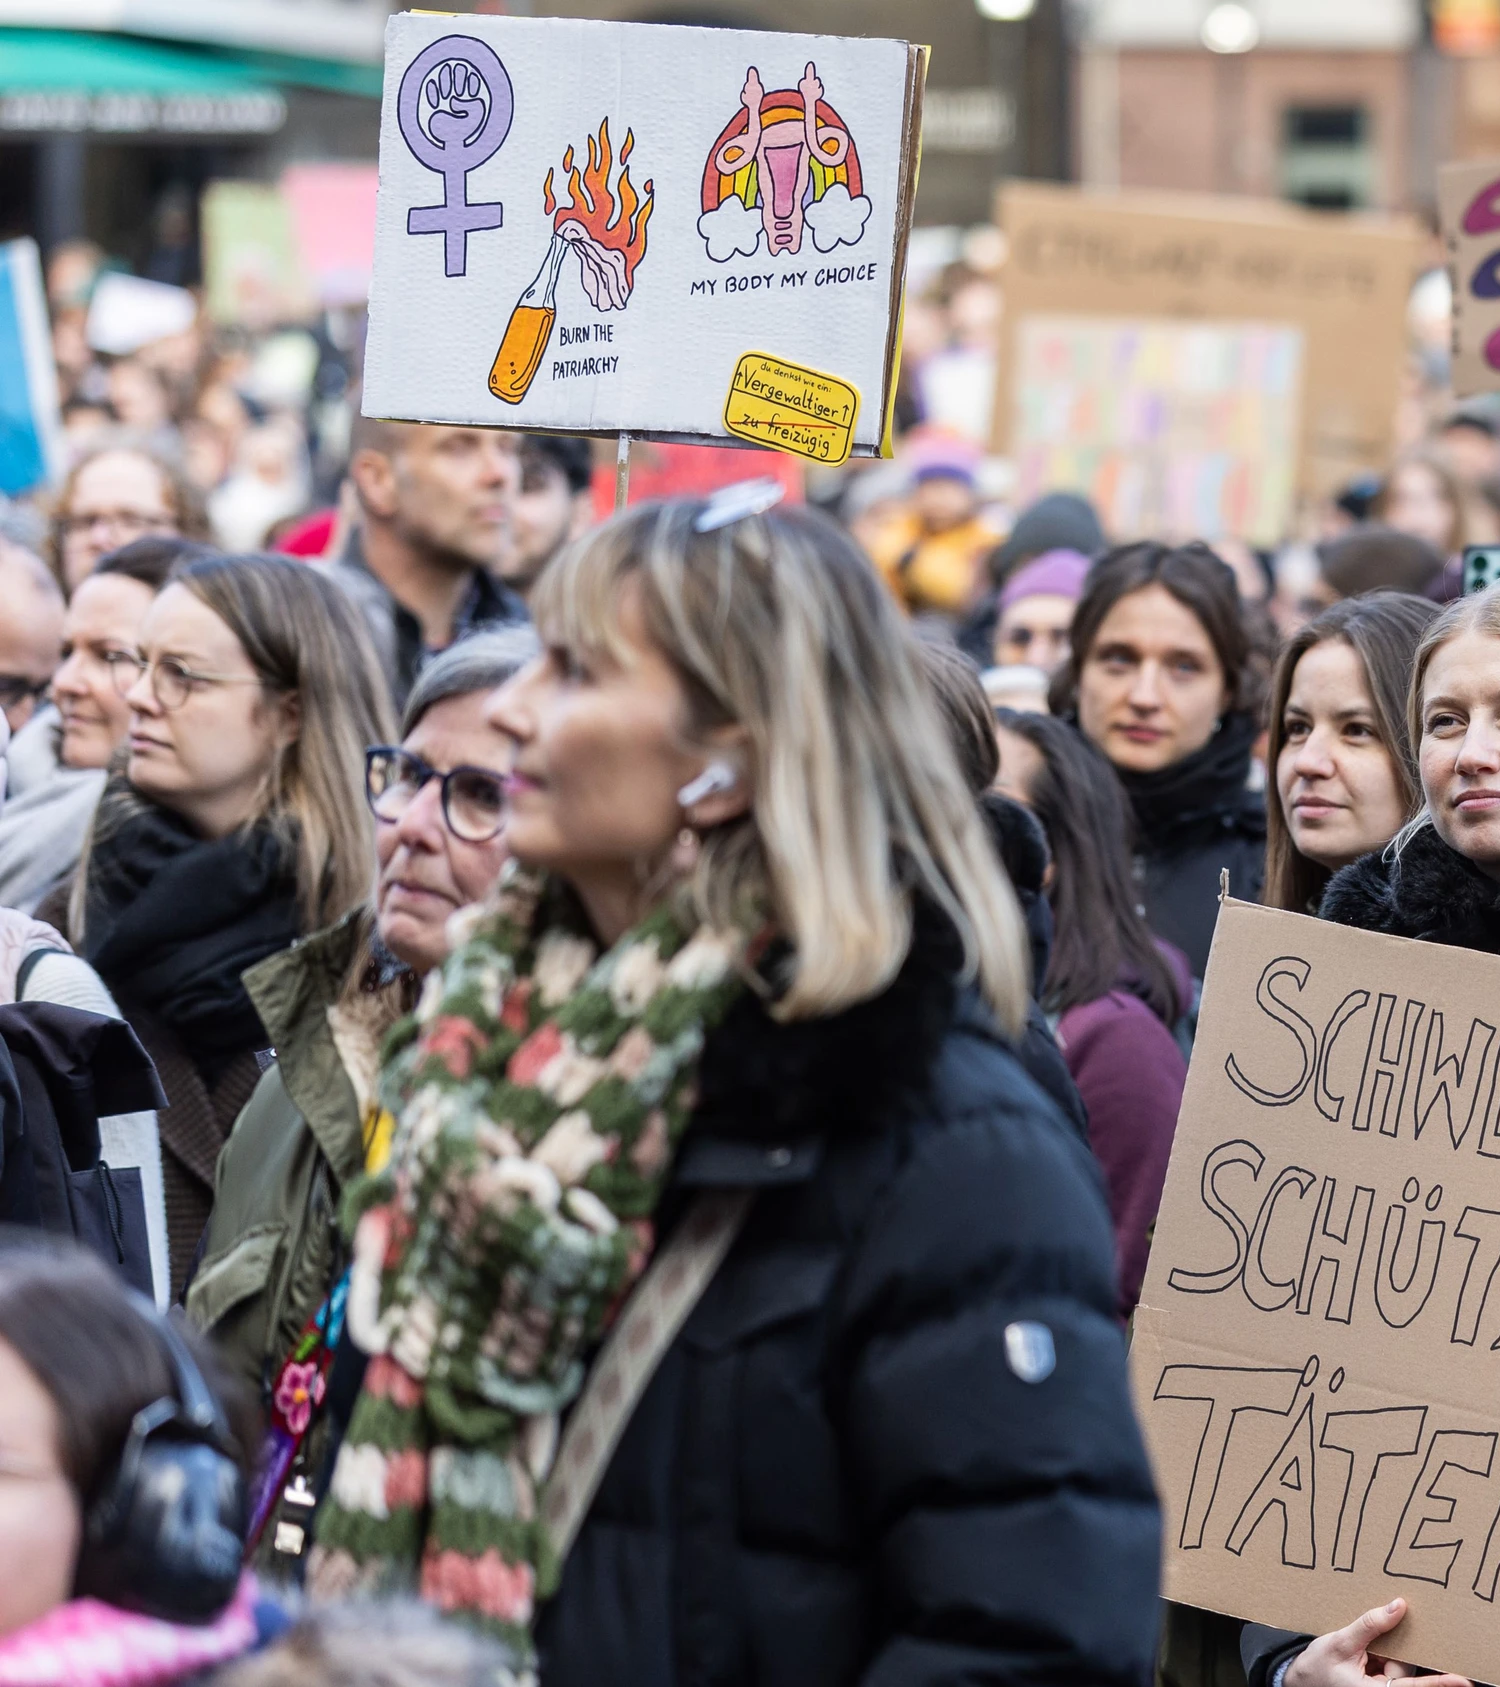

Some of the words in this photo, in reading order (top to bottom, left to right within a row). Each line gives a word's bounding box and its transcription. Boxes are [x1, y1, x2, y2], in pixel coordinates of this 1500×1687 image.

[690, 279, 717, 295] MY
[725, 273, 775, 293] BODY
[780, 270, 808, 288] MY
[814, 262, 878, 287] CHOICE
[559, 324, 590, 347] BURN
[592, 323, 614, 343] THE
[552, 355, 619, 381] PATRIARCHY
[760, 362, 771, 373] du
[773, 367, 802, 383] denkst
[803, 378, 815, 388] wie
[817, 383, 832, 393] ein:
[744, 364, 839, 418] Vergewaltiger
